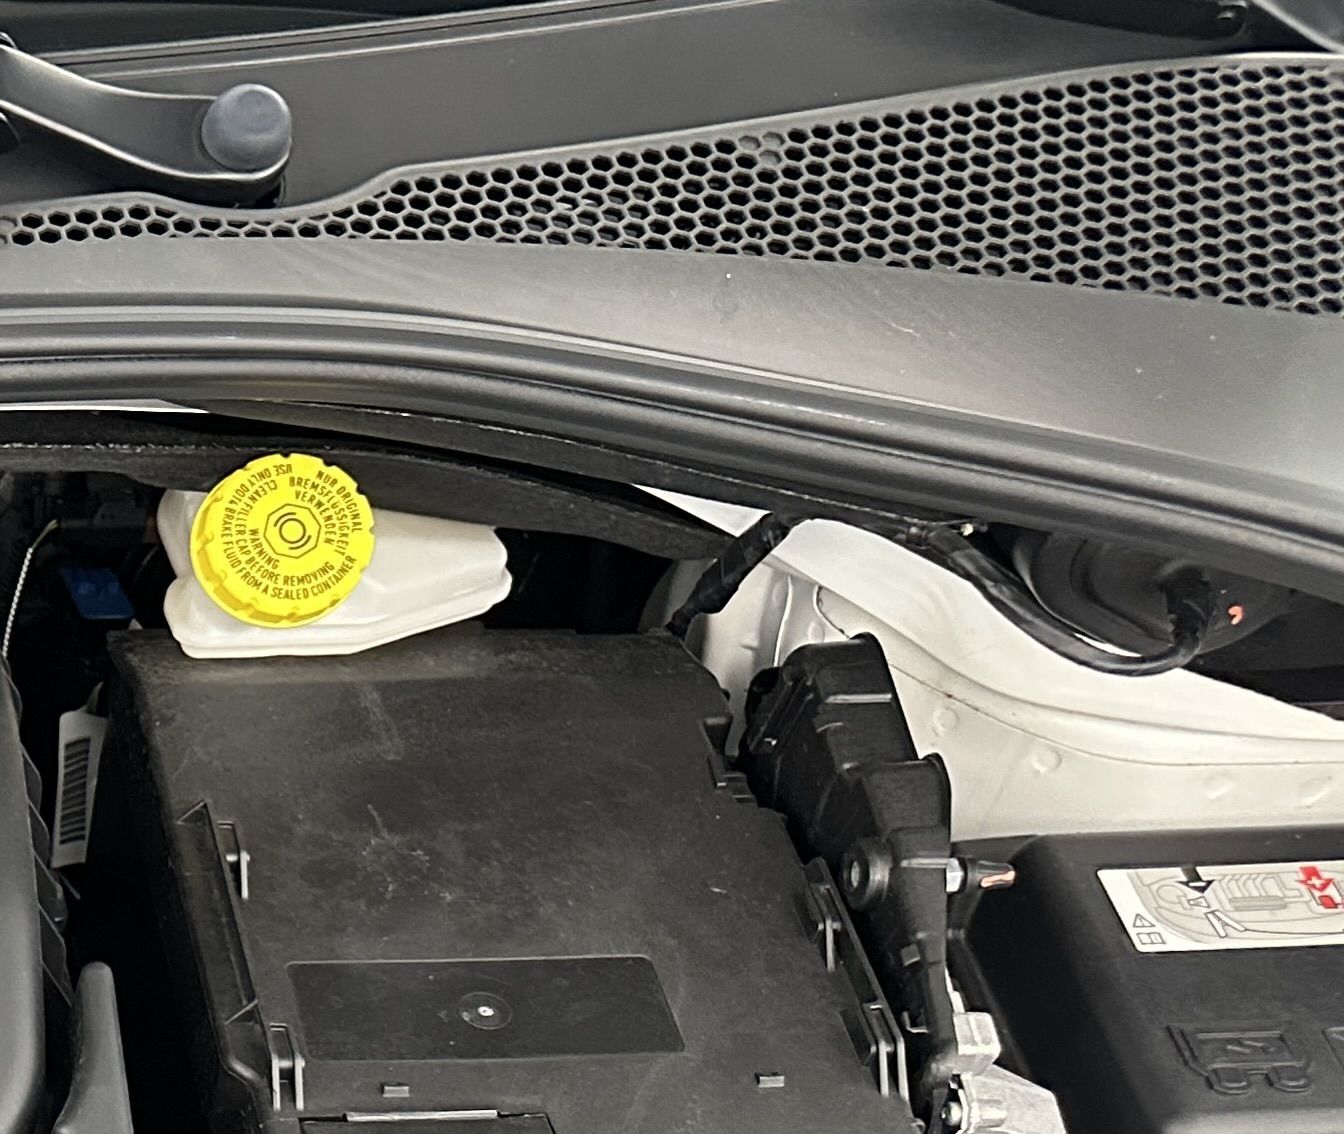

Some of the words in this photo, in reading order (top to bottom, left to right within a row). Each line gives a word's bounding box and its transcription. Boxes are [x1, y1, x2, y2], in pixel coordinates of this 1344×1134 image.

[248, 468, 271, 487] ONLY
[273, 463, 293, 475] USE
[248, 480, 278, 504] CLEAN
[316, 470, 338, 487] NUR
[336, 486, 363, 534] ORIGINAL
[221, 506, 237, 539] BRAKE
[234, 502, 253, 536] FILLER
[295, 490, 337, 545] VERWENDEN
[222, 540, 242, 568] FLUID
[235, 539, 251, 556] CAP
[249, 528, 280, 570] WARNING
[236, 567, 262, 590] FROM
[245, 556, 280, 584] BEFORE
[283, 561, 335, 587] REMOVING
[311, 555, 357, 597] CONTAINER
[261, 585, 269, 596] A
[271, 587, 309, 600] SEALED
